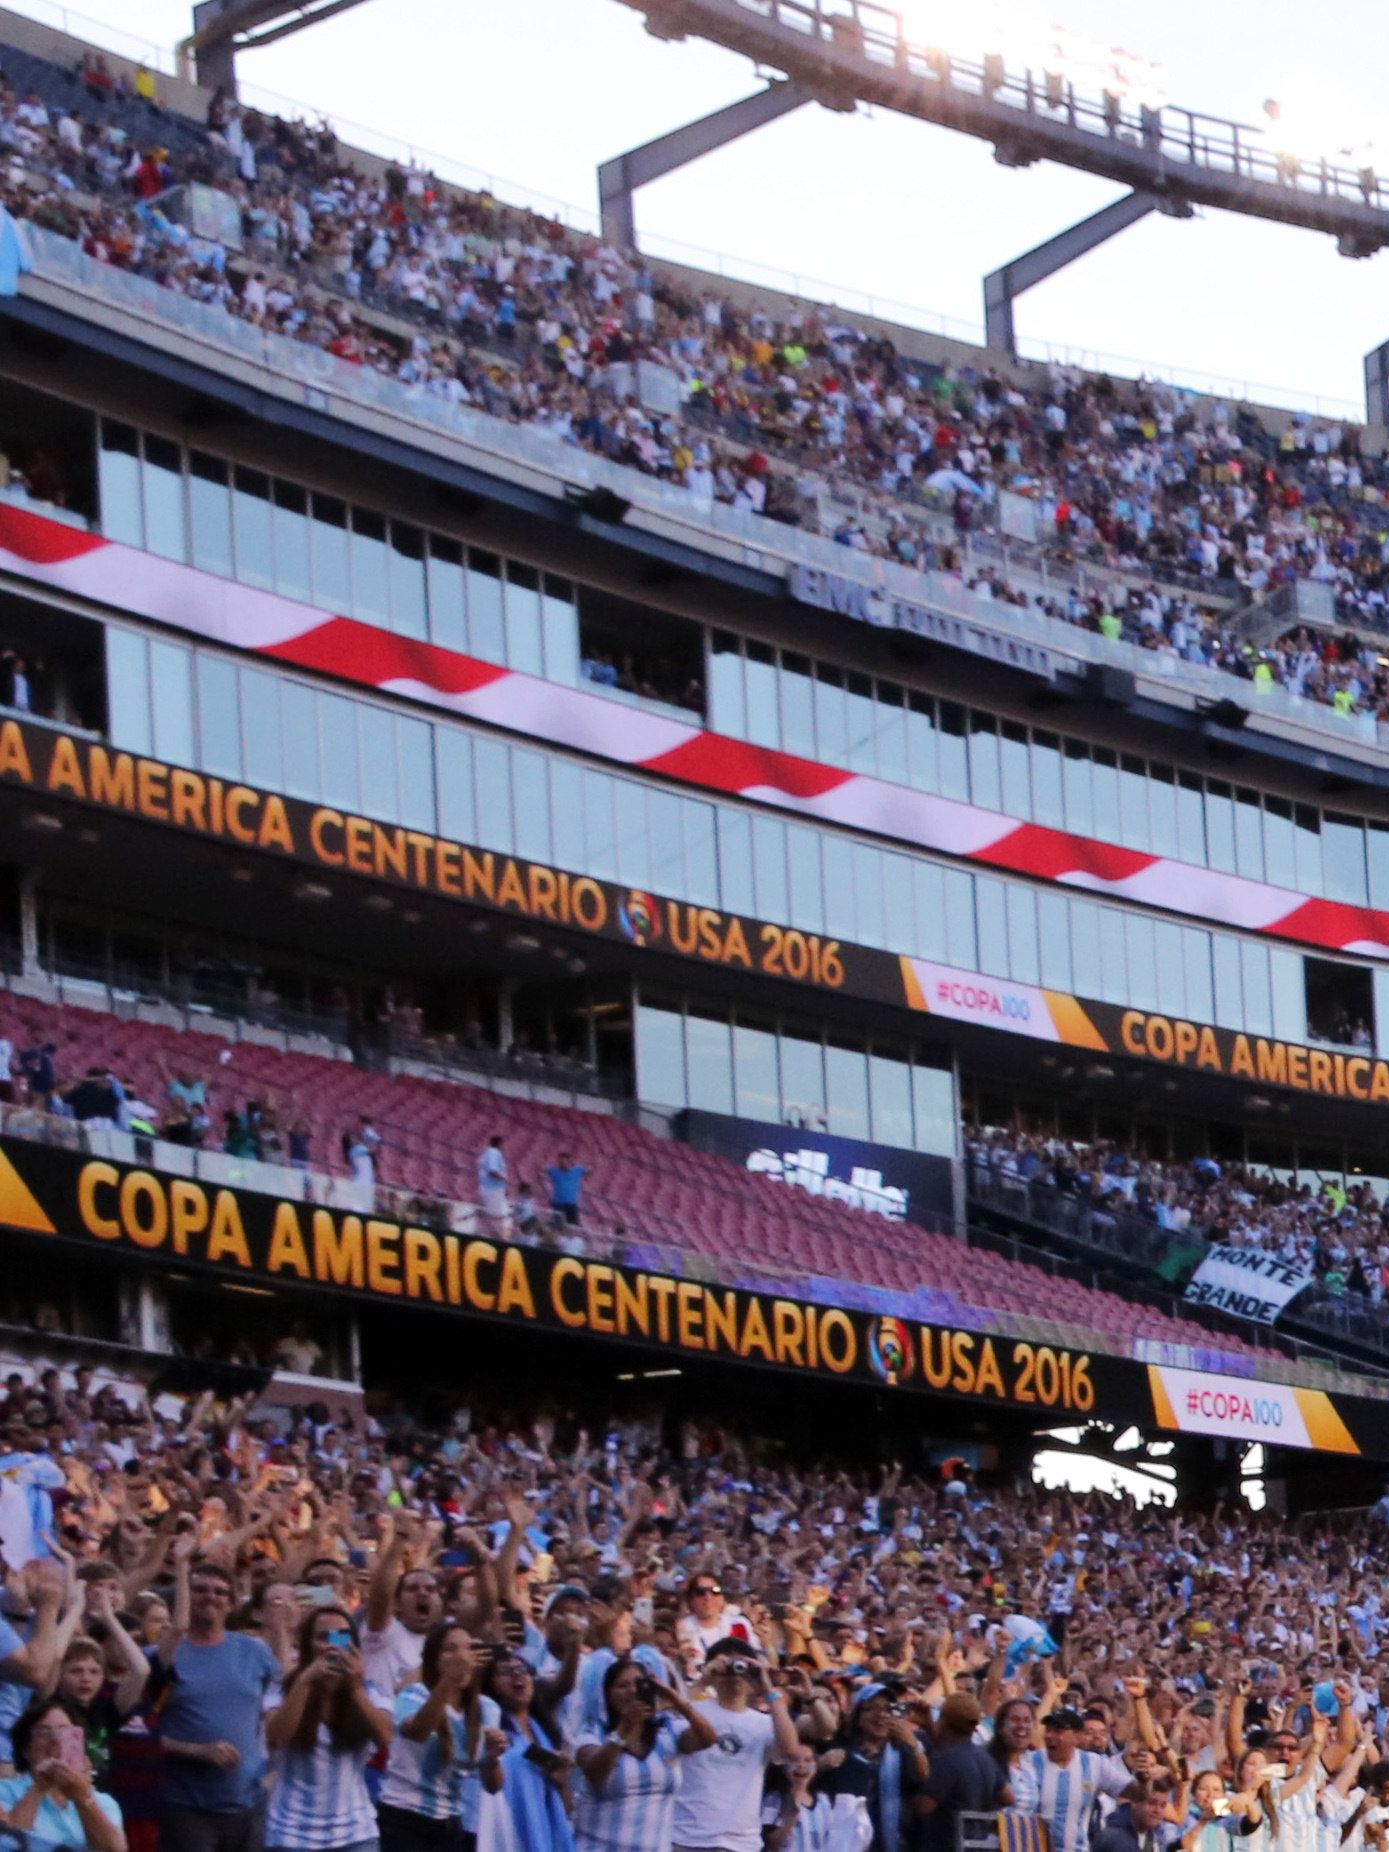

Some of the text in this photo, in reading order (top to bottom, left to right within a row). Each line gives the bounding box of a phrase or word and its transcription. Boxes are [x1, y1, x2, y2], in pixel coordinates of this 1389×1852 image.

[48, 735, 294, 854] AMERICA
[309, 808, 607, 929] CENTENARIO
[667, 902, 752, 967] USA
[761, 924, 844, 987] 2016
[937, 981, 1029, 1021] #COPA100
[1122, 1010, 1222, 1070] COPA
[78, 1161, 1094, 1411] COPA AMERICA CENTENARIO USA 2016
[1210, 1248, 1305, 1287] MONTE
[1183, 1281, 1279, 1322] GRANDE
[1186, 1387, 1283, 1428] #COPA100
